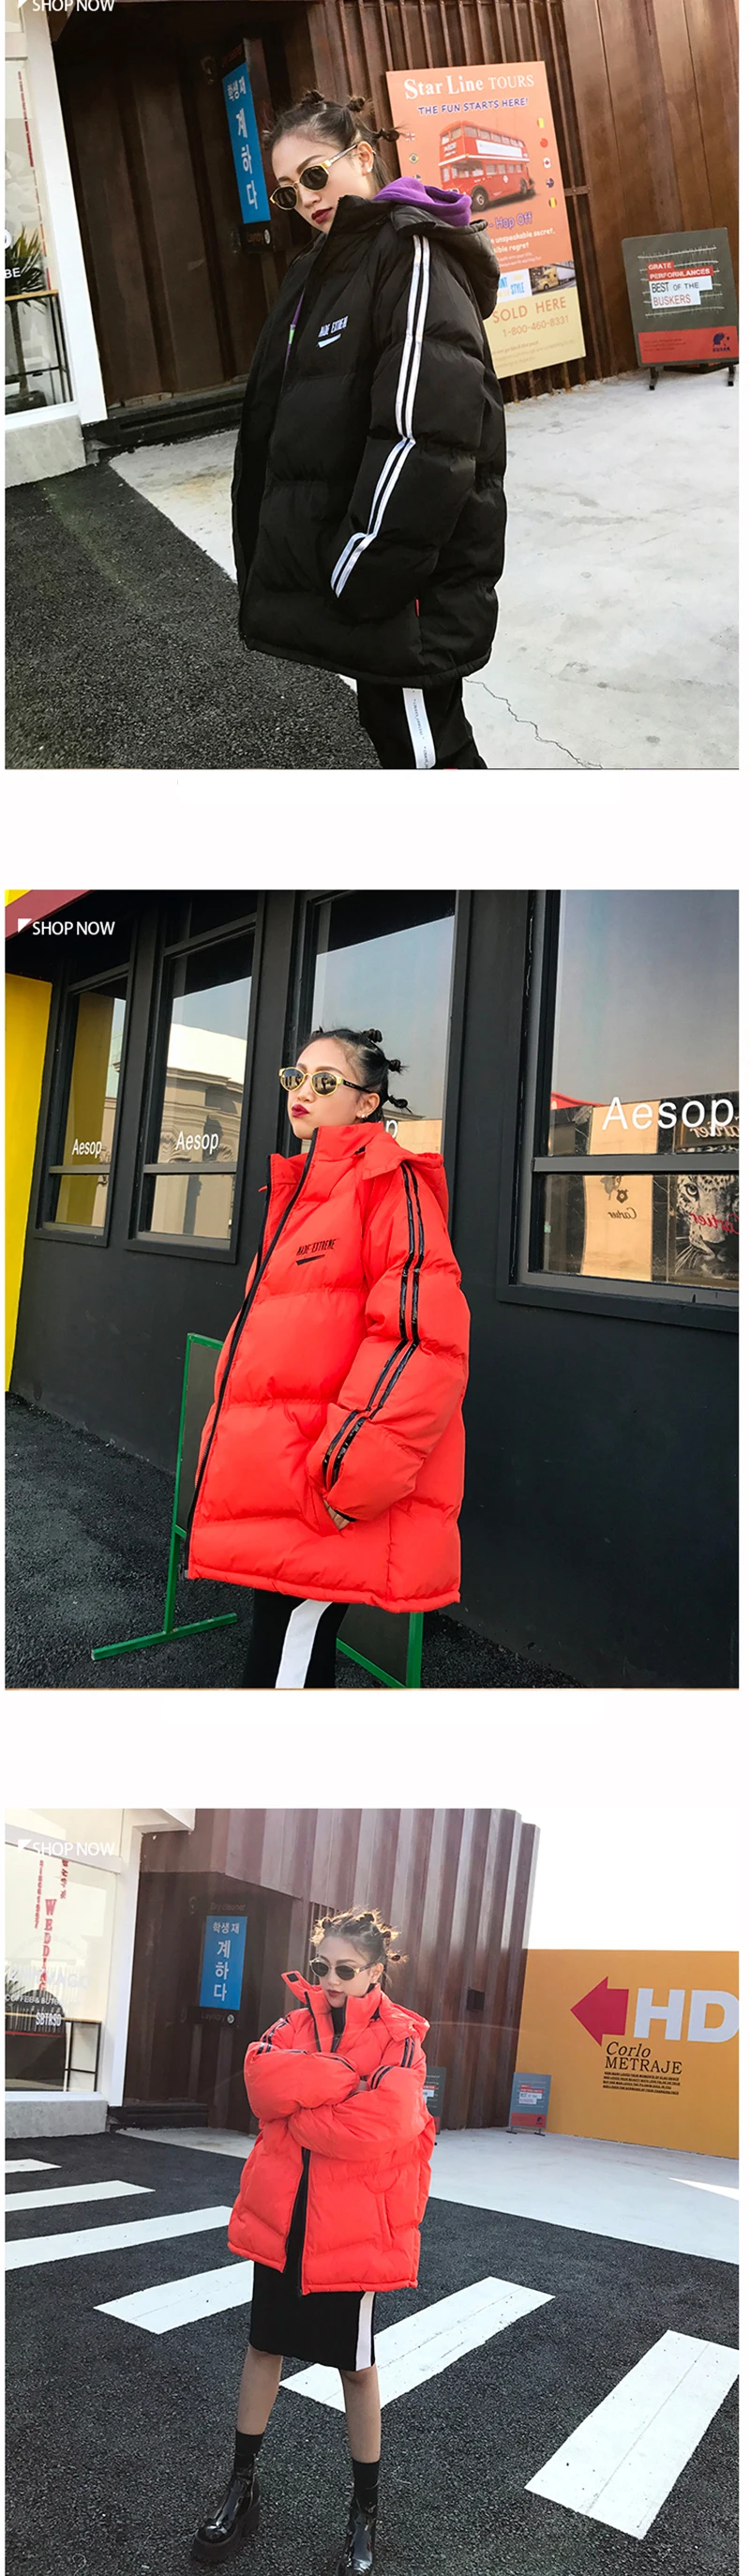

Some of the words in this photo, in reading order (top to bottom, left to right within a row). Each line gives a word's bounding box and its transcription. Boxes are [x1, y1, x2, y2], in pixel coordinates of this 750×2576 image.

[404, 78, 443, 100] Star
[446, 75, 484, 94] Line
[488, 74, 534, 90] TOURS
[418, 105, 439, 115] THE
[441, 103, 461, 114] FUN
[463, 100, 499, 111] STARTS
[502, 97, 529, 107] HERE!
[495, 217, 515, 230] Hop
[517, 212, 532, 226] Off
[495, 232, 532, 244] unspeakable
[509, 242, 529, 252] regret
[510, 282, 525, 295] STYLE
[651, 282, 669, 293] BEST
[653, 294, 691, 306] BUSKERS
[492, 305, 528, 323] SOLD
[535, 296, 567, 314] HERE
[502, 315, 569, 337] 1-800-460-8331
[602, 1096, 734, 1137] Aesop
[72, 1138, 102, 1158] Aesop
[176, 1130, 219, 1155] Aesop
[212, 1922, 240, 1934] 학생재
[213, 1940, 231, 2002] 계하다
[634, 1988, 739, 2043] HD
[606, 2041, 651, 2058] Corlo
[605, 2056, 682, 2074] METRAJE
